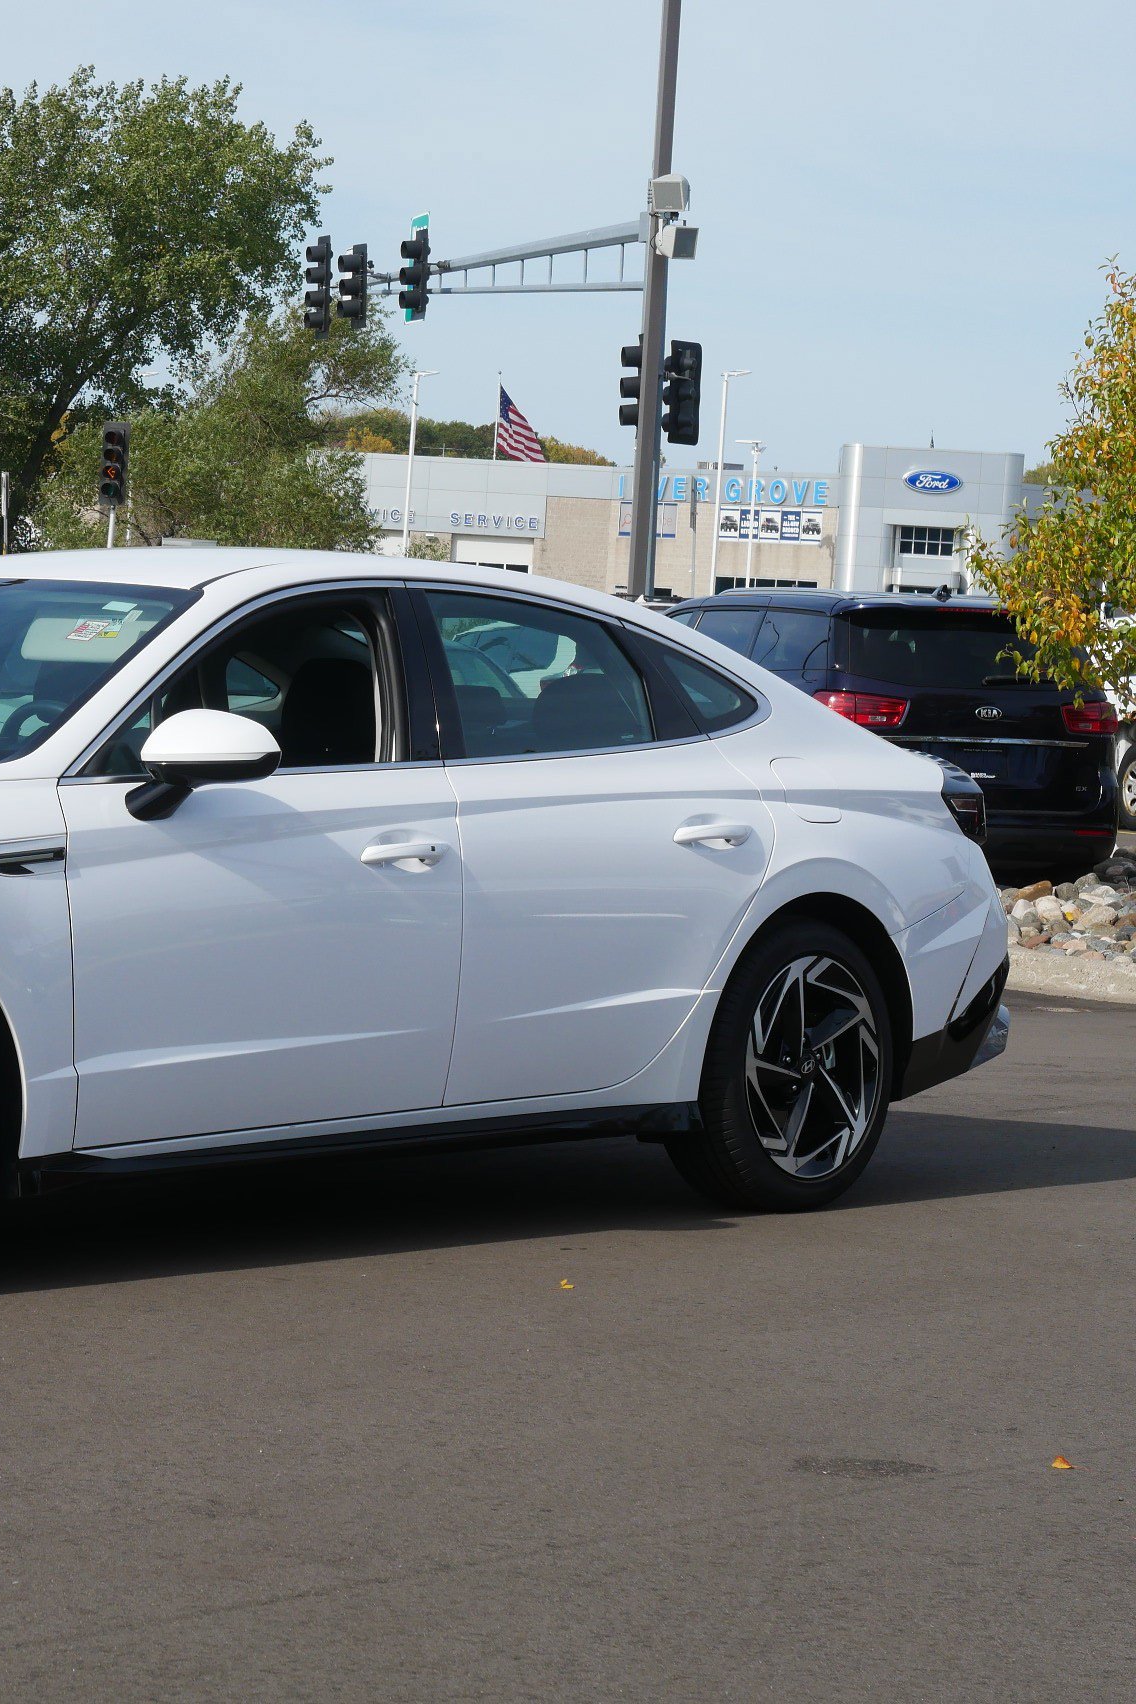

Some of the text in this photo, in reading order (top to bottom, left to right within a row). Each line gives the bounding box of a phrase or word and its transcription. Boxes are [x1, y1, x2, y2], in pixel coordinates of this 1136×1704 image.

[915, 473, 950, 489] Ford
[618, 474, 828, 506] IVER GROVE
[450, 512, 538, 530] SERVICE
[980, 708, 999, 718] KIA
